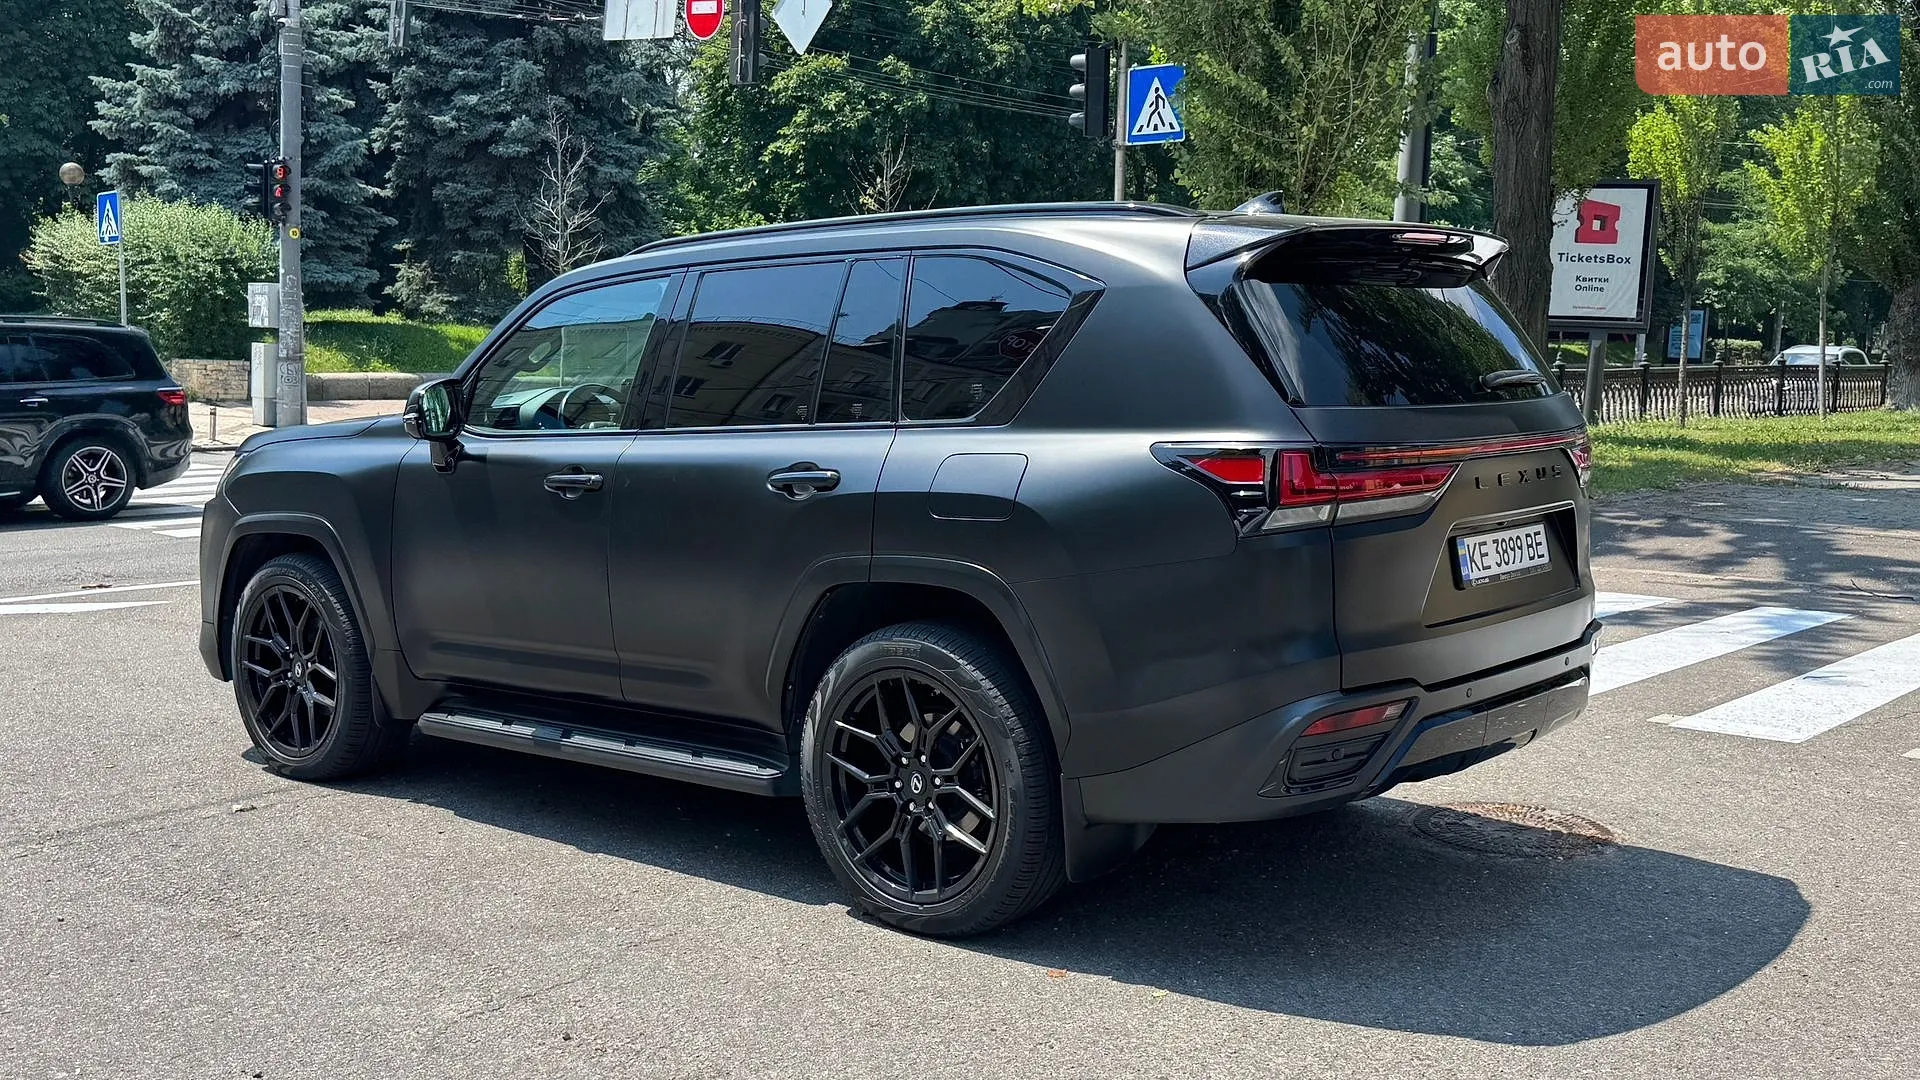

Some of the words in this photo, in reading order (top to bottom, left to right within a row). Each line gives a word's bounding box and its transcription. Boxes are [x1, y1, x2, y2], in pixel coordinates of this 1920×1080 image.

[1558, 252, 1631, 265] TicketsBox
[1575, 275, 1609, 283] Квитки
[1574, 284, 1605, 292] Online
[1474, 464, 1562, 490] LEXUS
[1467, 540, 1491, 573] KE
[1492, 534, 1523, 567] 3899
[1524, 530, 1545, 561] BE
